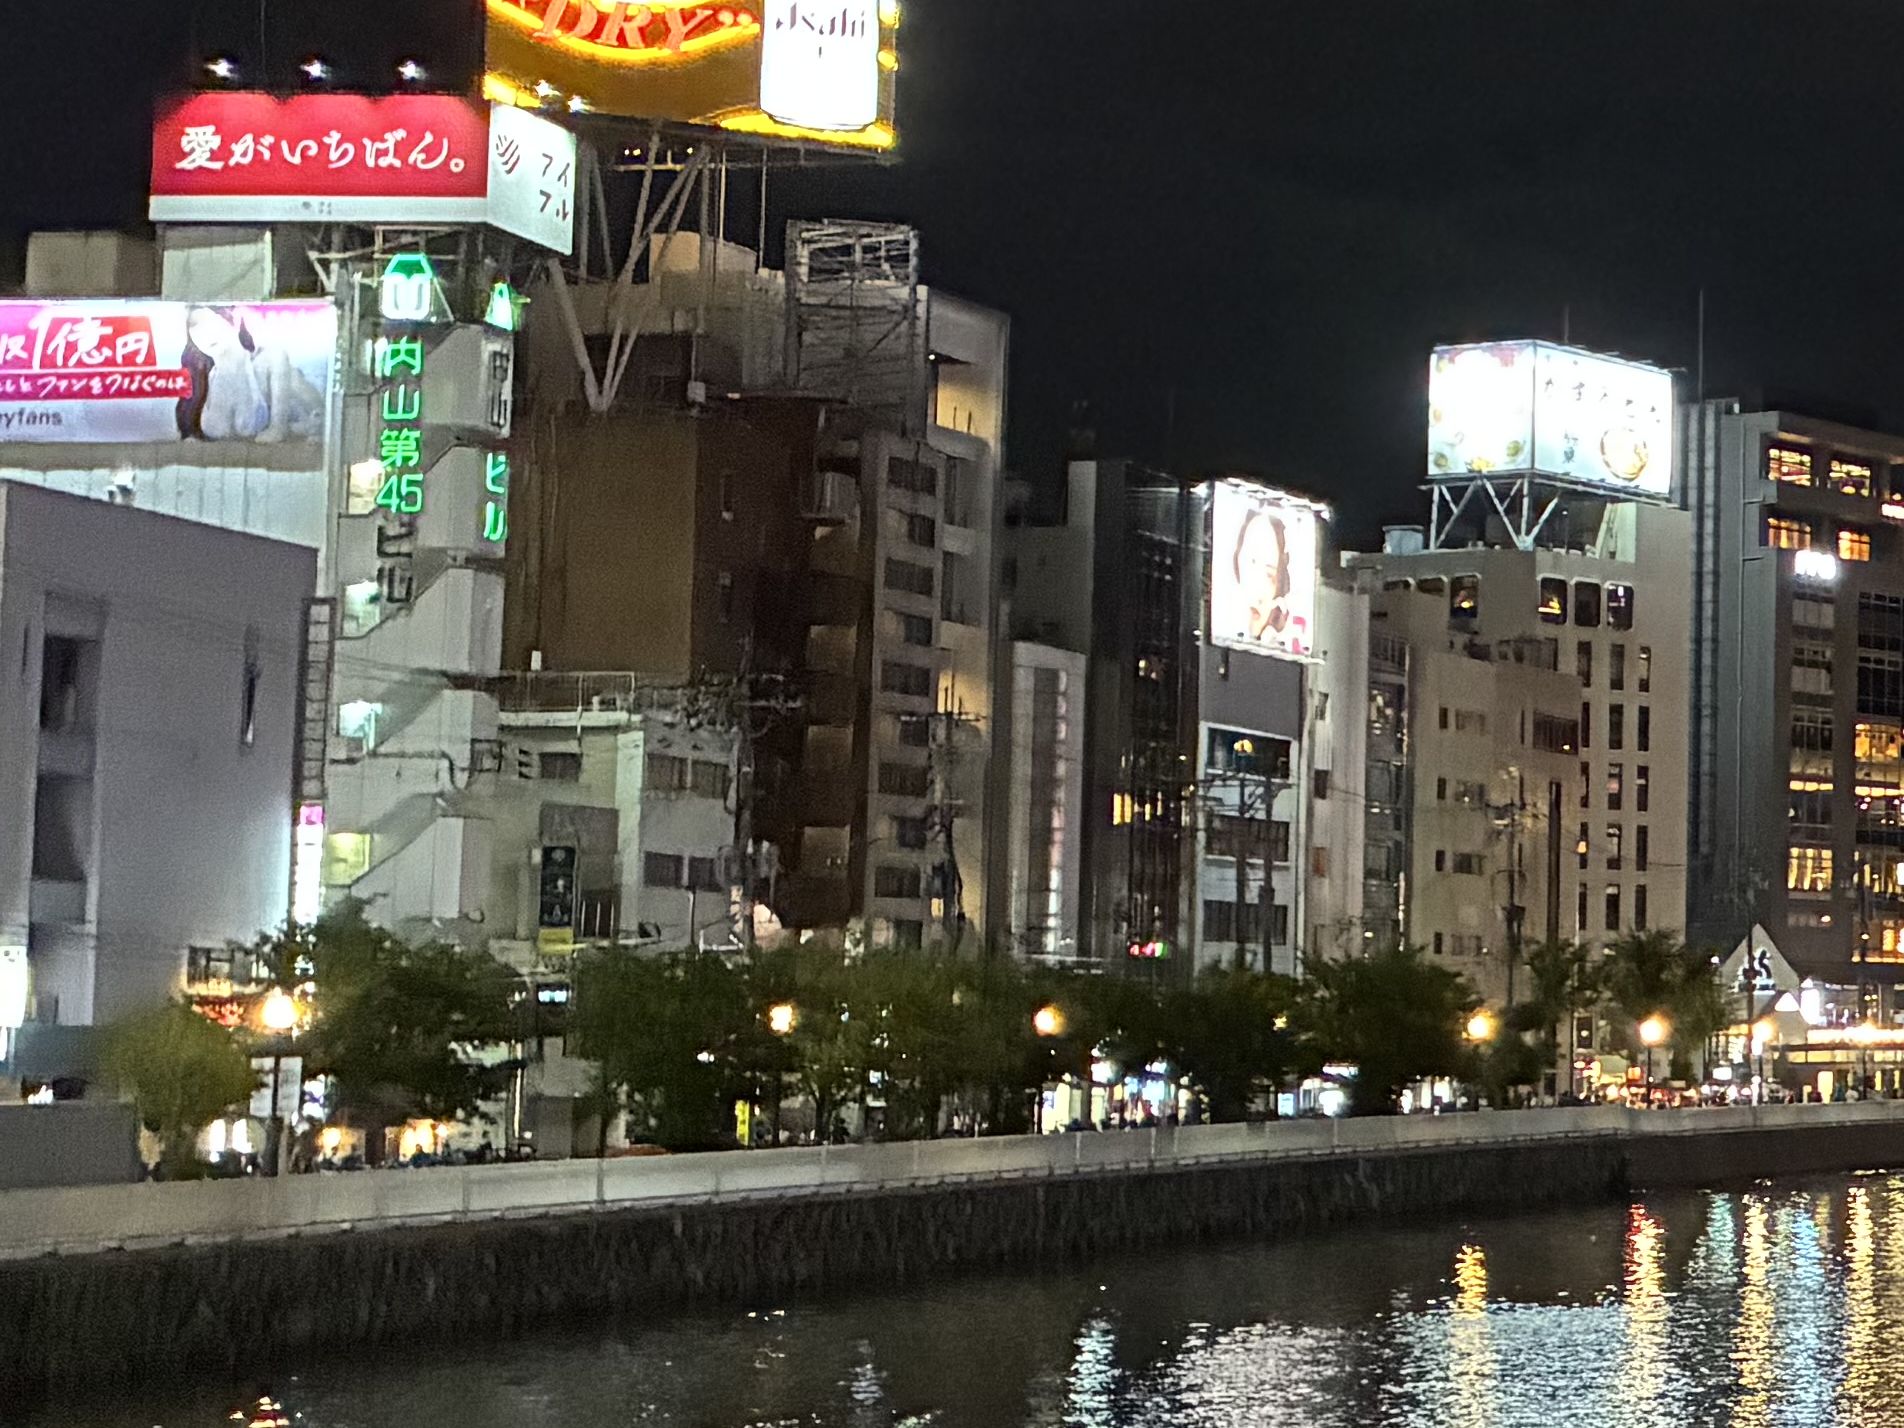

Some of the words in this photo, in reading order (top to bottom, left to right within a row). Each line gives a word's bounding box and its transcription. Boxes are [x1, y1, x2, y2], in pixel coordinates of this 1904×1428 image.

[175, 125, 466, 174] 愛がいちばん。
[0, 374, 188, 399] しとファンをつなぐのは
[0, 408, 63, 428] yfans
